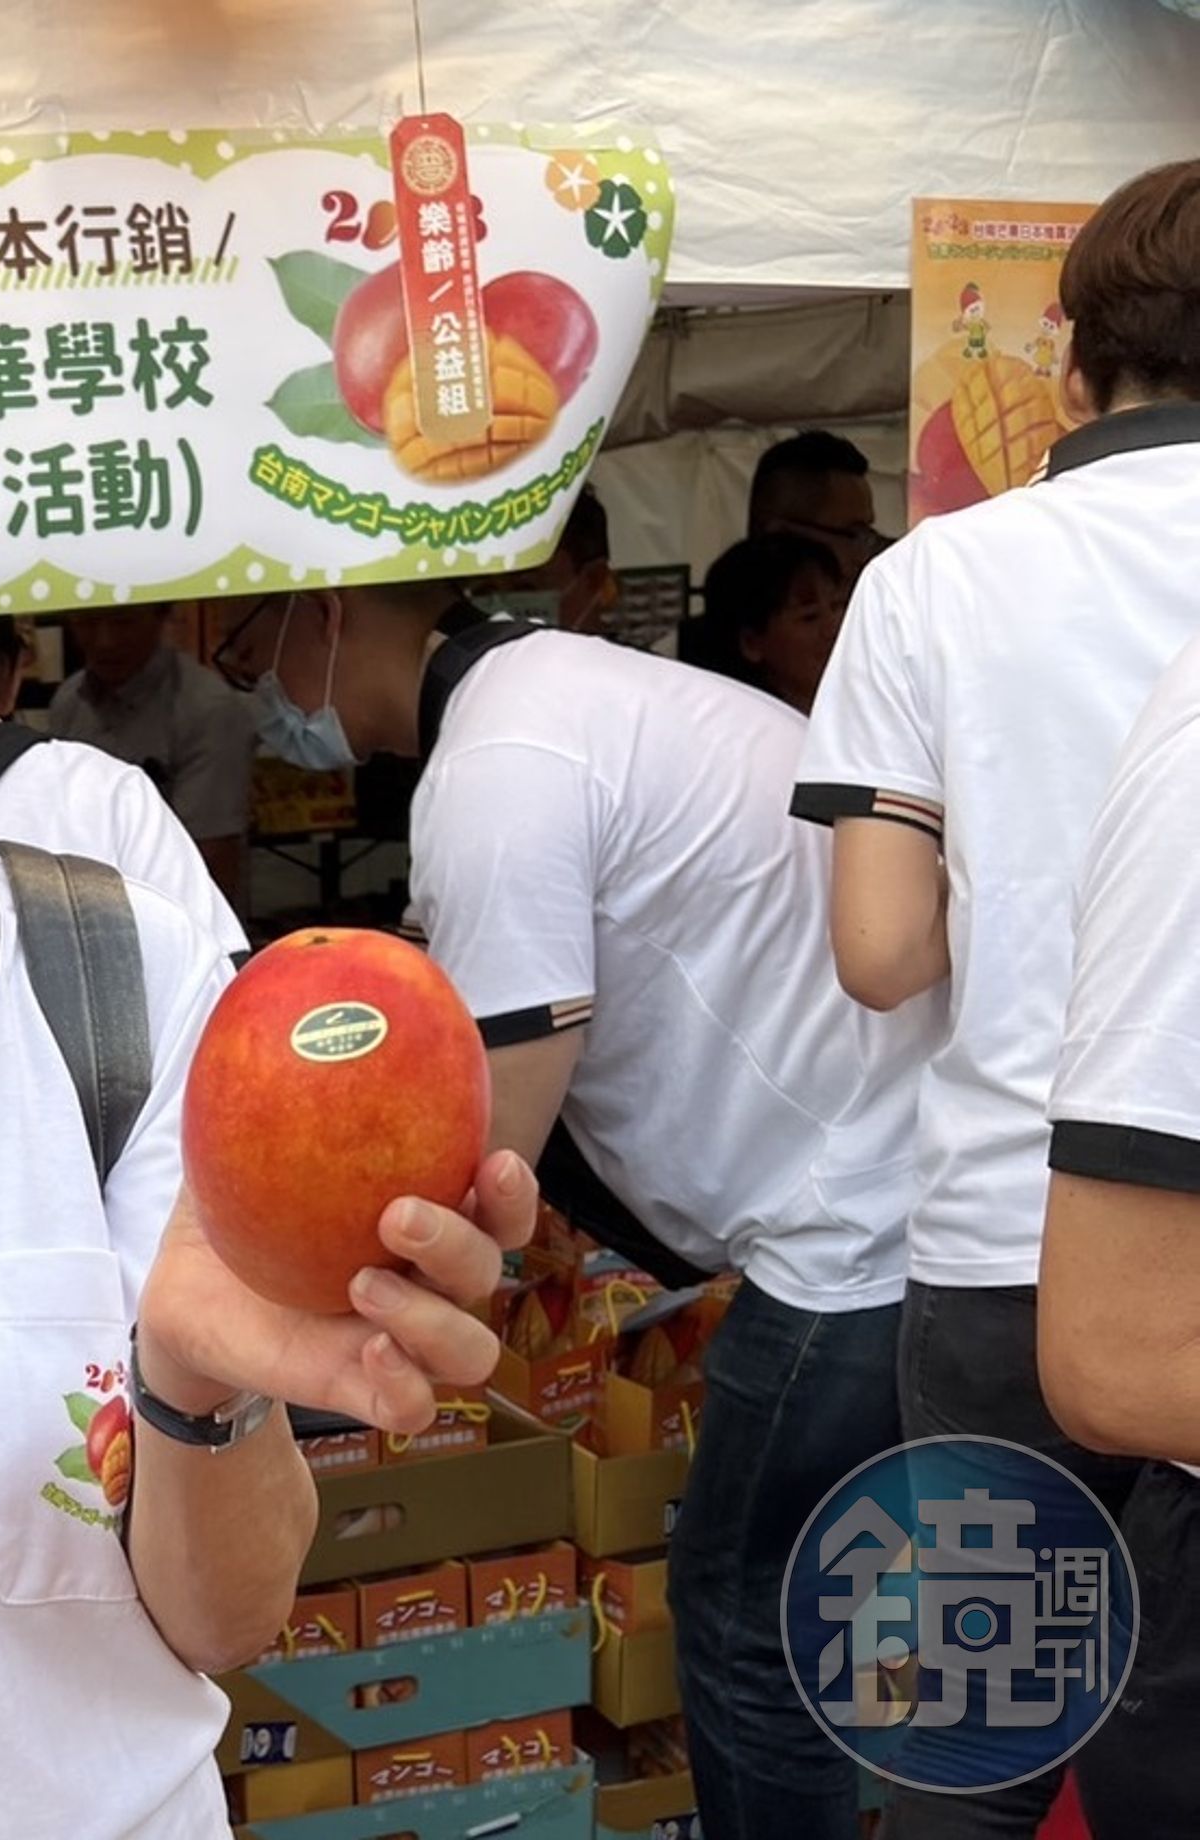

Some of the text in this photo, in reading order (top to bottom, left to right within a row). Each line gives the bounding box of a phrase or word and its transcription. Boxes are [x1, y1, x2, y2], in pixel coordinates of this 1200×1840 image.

[376, 1601, 455, 1627] マンゴー
[370, 1761, 454, 1785] マンゴー
